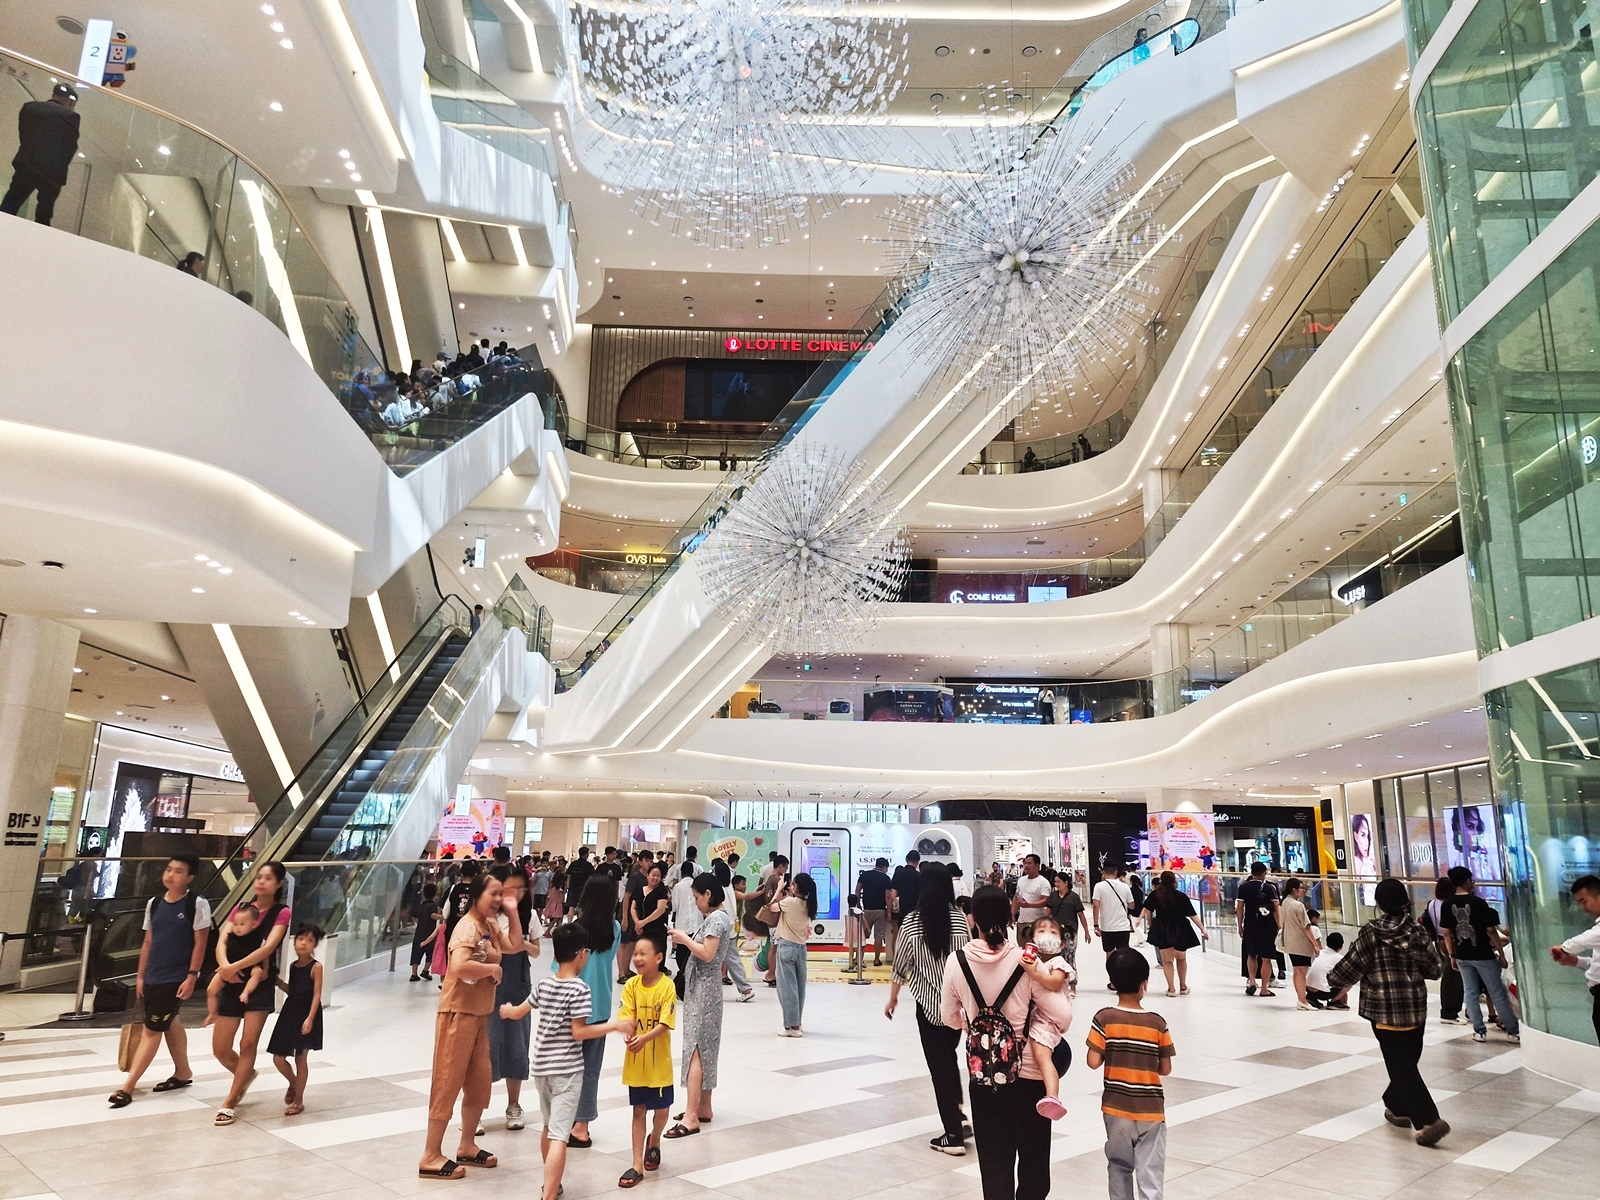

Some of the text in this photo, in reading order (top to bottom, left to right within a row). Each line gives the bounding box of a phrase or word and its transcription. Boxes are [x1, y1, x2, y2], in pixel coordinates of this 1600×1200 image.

[90, 46, 100, 57] 2
[745, 339, 875, 352] LOTTE CINEMA
[625, 554, 648, 564] OVS
[967, 593, 1016, 601] COME HOME
[7, 812, 31, 828] B1F
[713, 840, 737, 853] LOVELY
